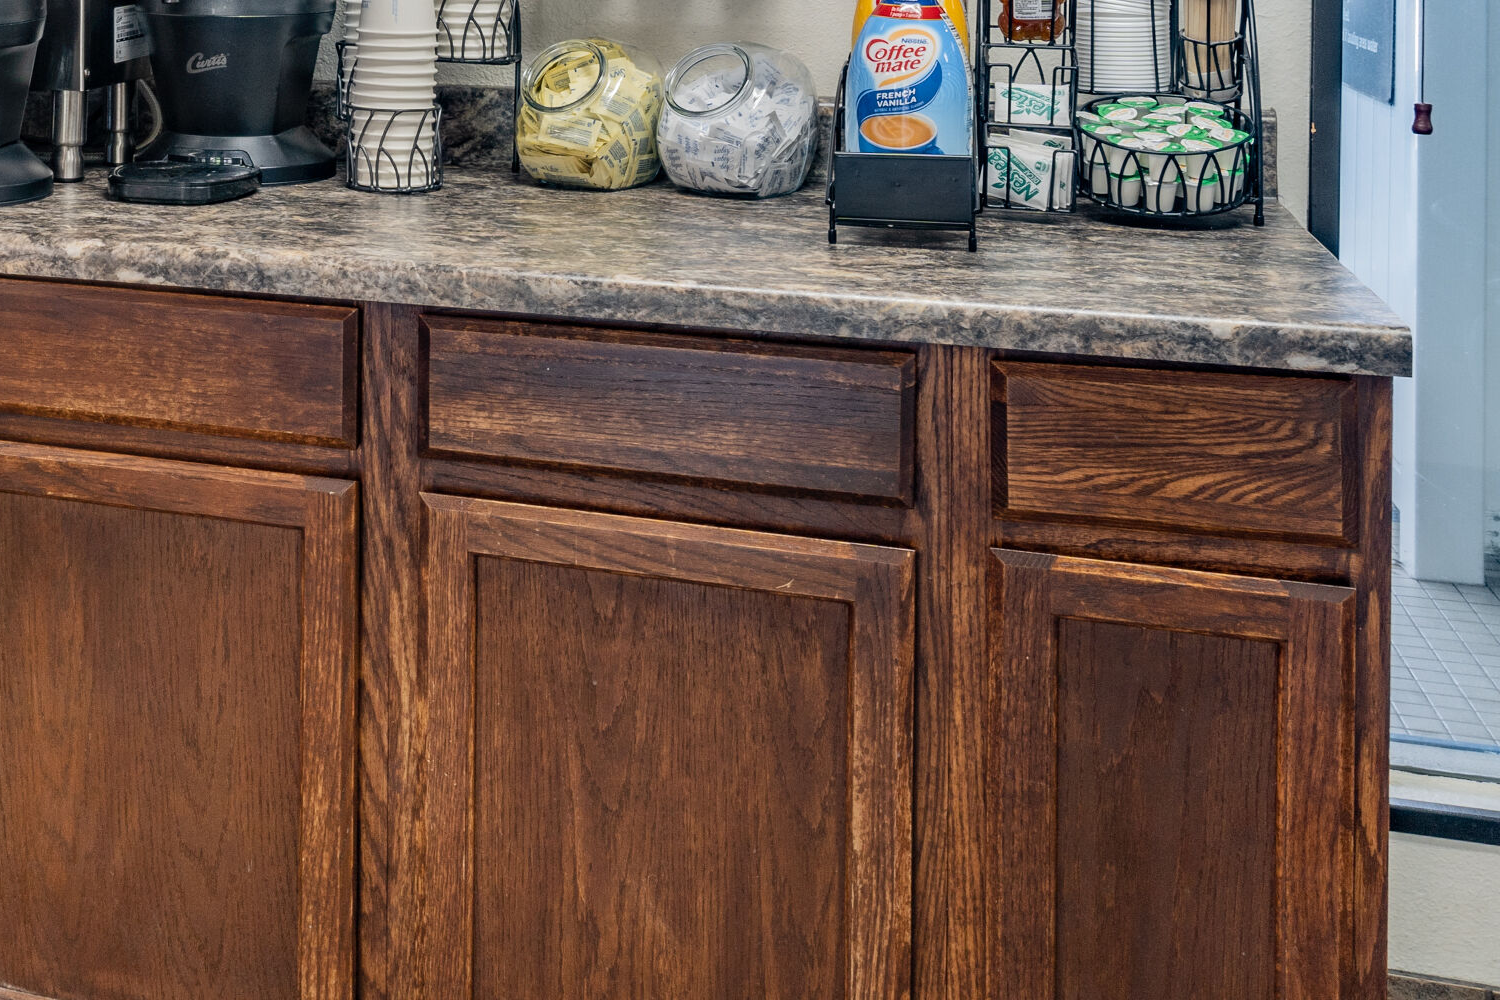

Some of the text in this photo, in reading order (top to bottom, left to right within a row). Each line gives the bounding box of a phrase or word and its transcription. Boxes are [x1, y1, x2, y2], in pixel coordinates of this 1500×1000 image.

[866, 38, 927, 63] Coffee
[186, 52, 230, 74] Curtis
[874, 58, 922, 73] mate
[876, 88, 916, 100] FRENCH
[876, 96, 917, 108] VANILLA
